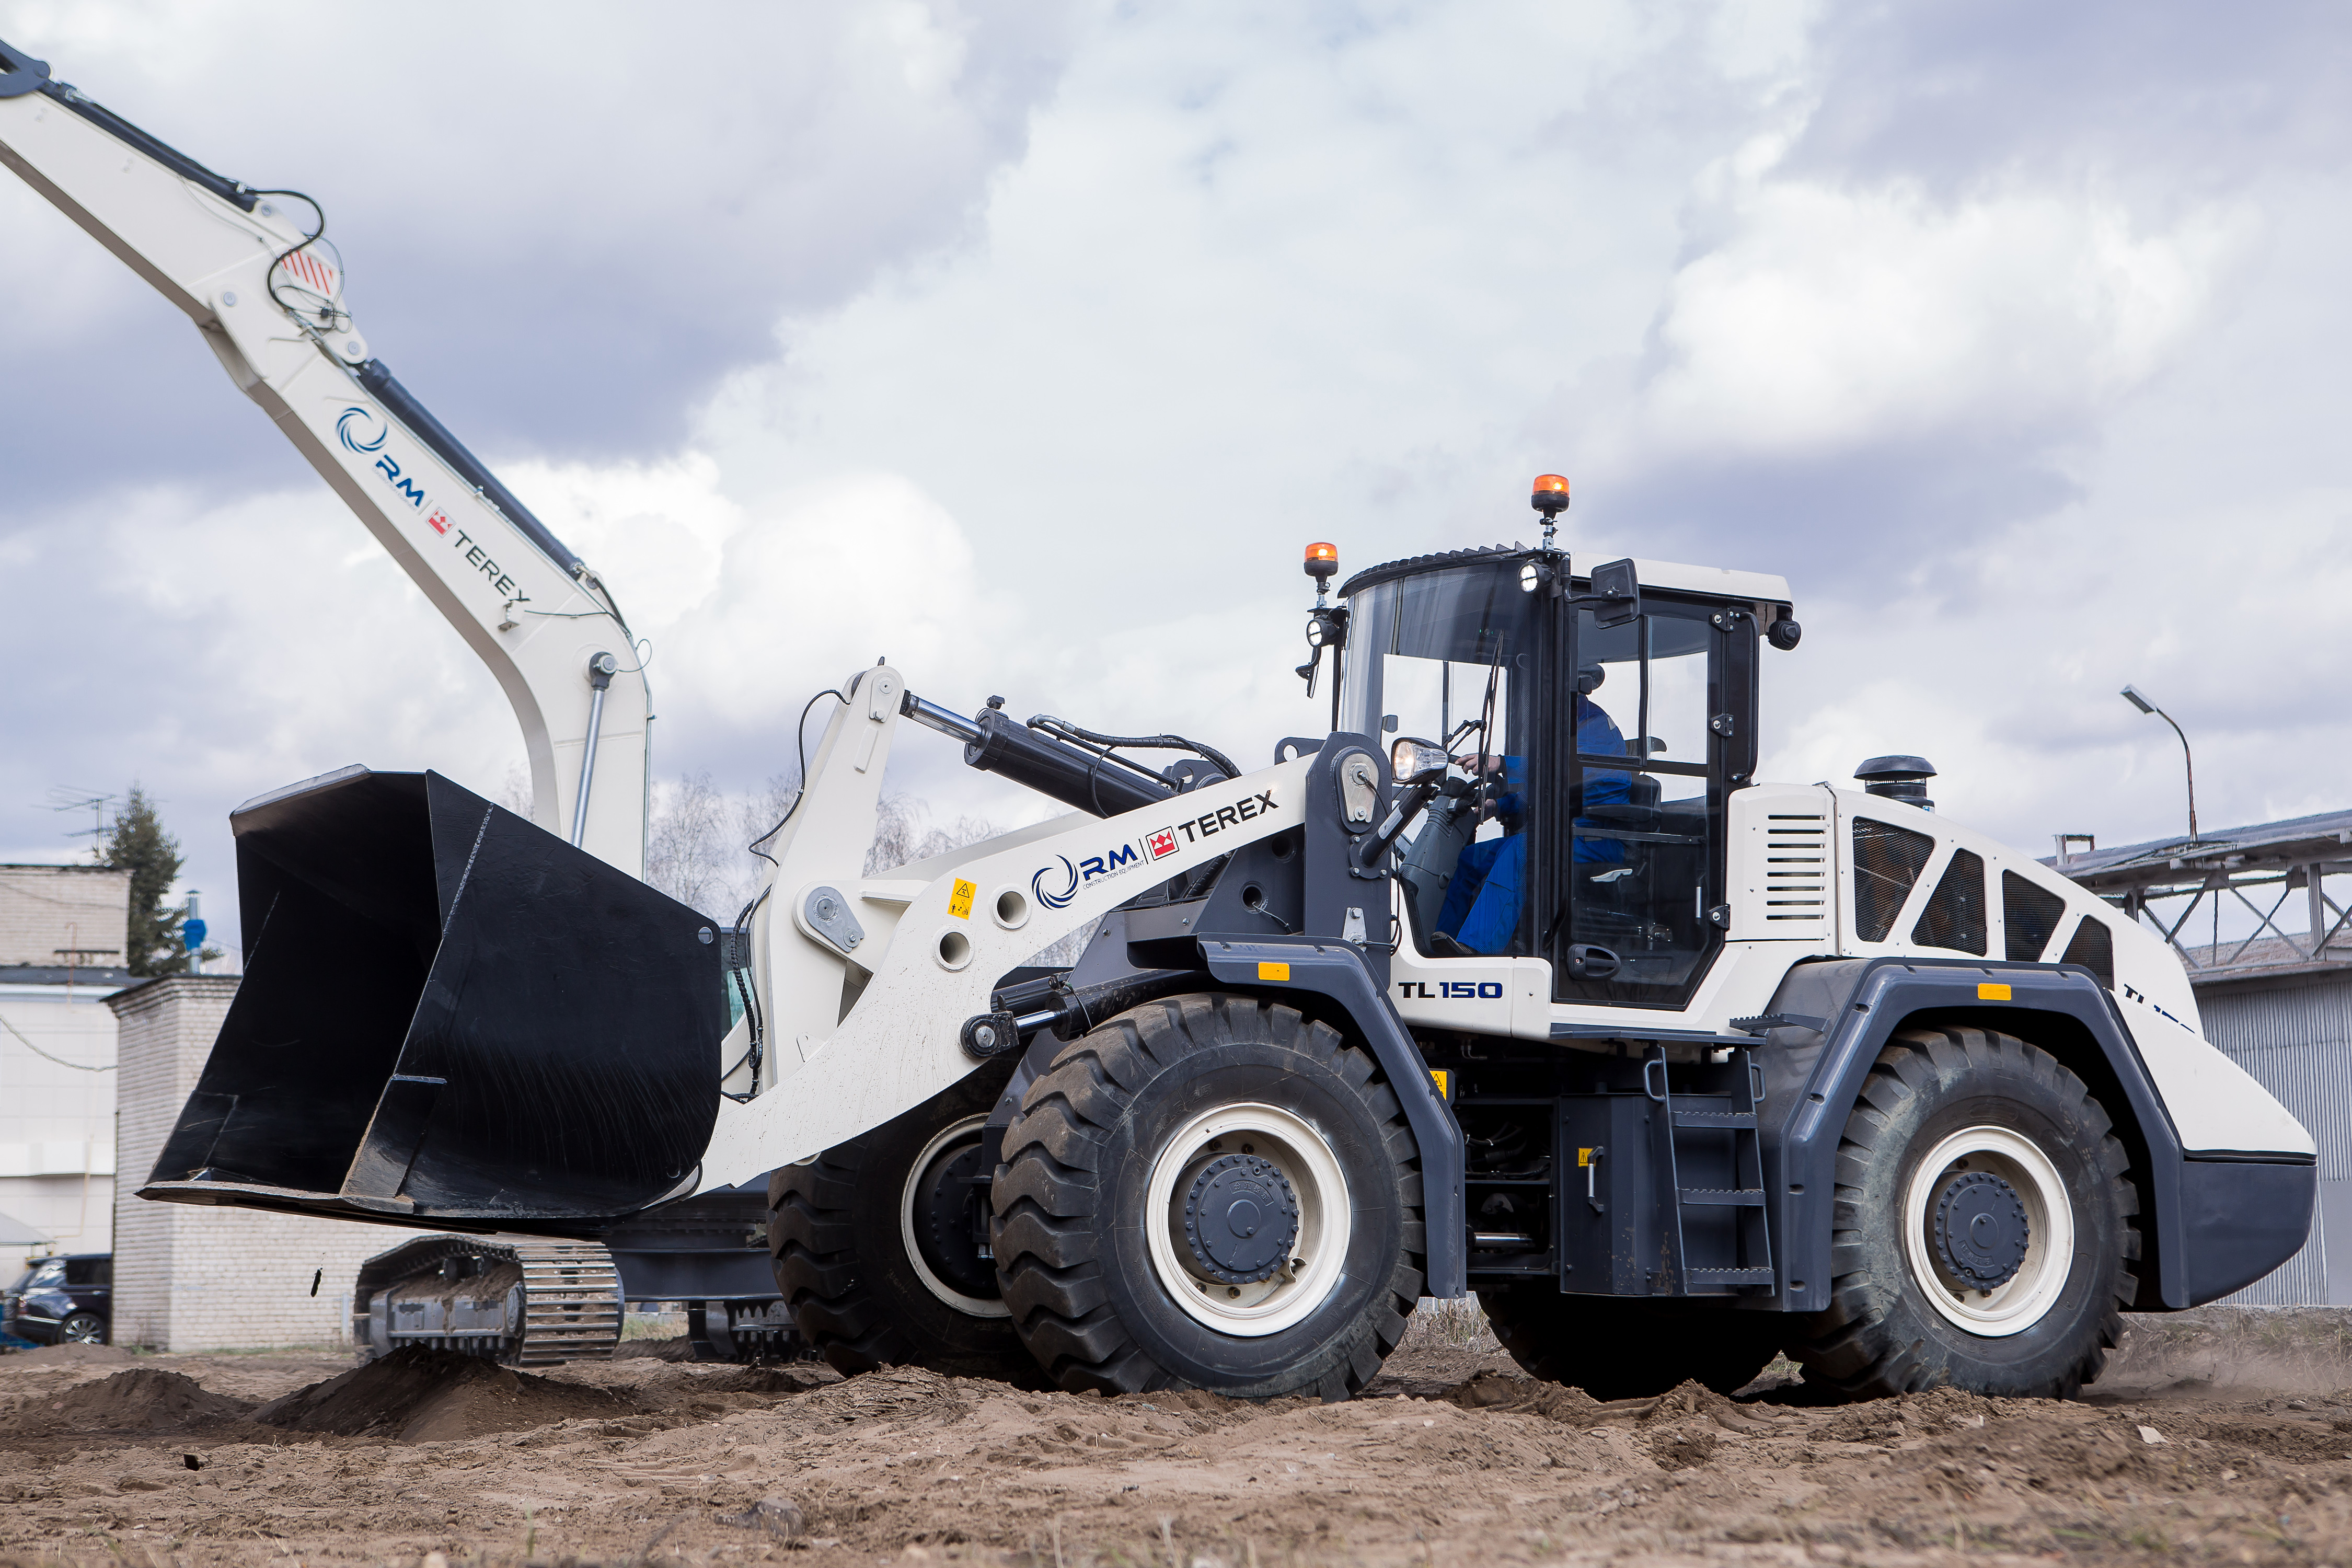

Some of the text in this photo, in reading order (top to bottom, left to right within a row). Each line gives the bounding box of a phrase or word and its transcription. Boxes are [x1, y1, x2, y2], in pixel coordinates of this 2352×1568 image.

[375, 454, 424, 507] RM
[1079, 789, 1279, 881] RM TEREX
[1082, 860, 1145, 890] CONSTRUCTION EQUIPMENT
[1398, 982, 1503, 999] TL150
